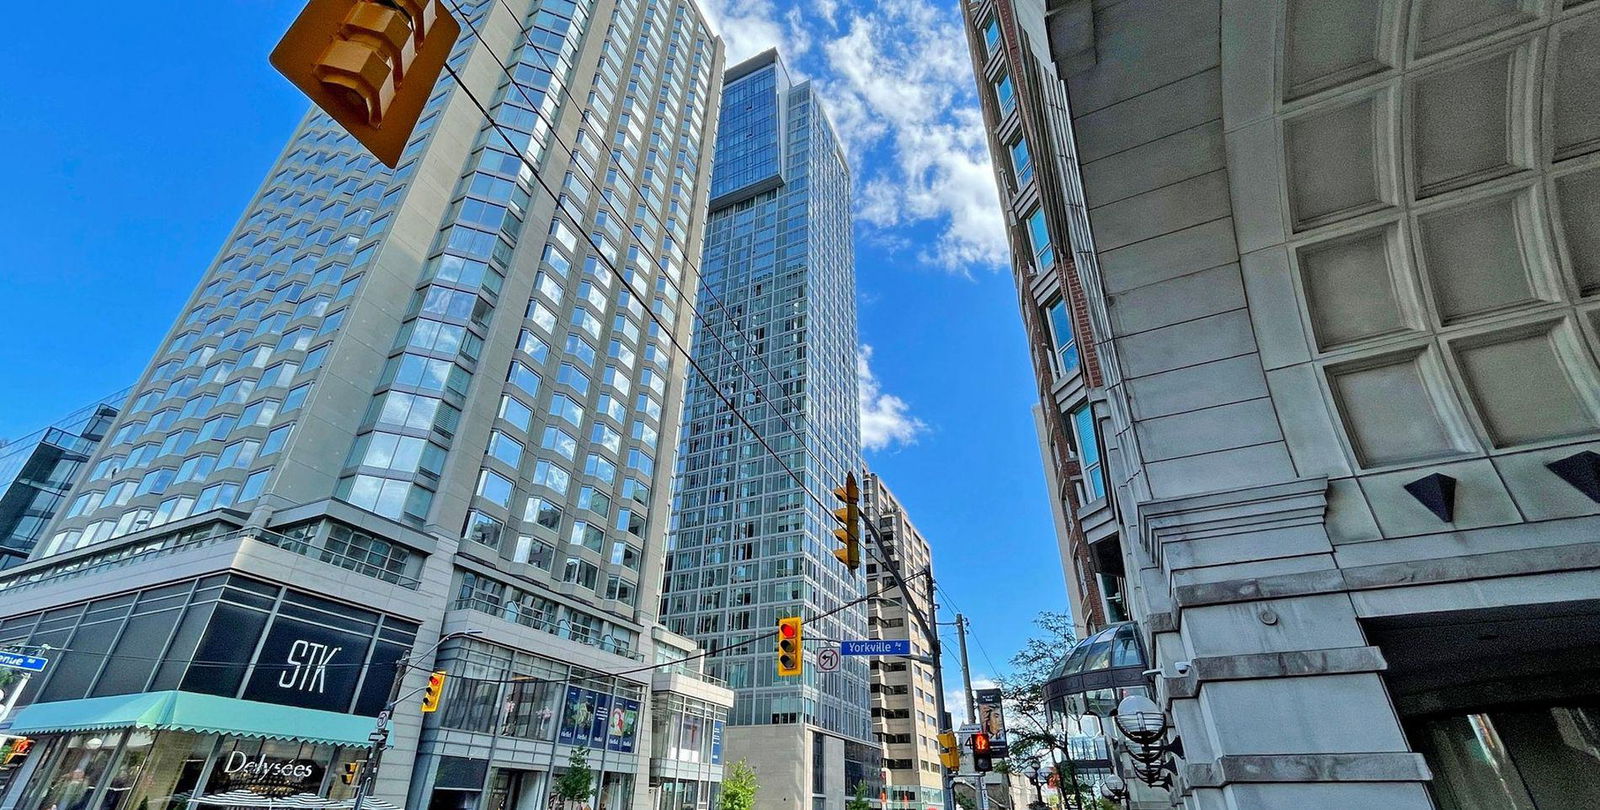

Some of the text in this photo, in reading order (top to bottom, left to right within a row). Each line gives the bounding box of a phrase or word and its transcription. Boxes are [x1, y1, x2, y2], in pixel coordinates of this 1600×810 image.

[849, 642, 891, 653] Yorkville
[279, 640, 338, 693] STK
[224, 750, 312, 780] Delysées
